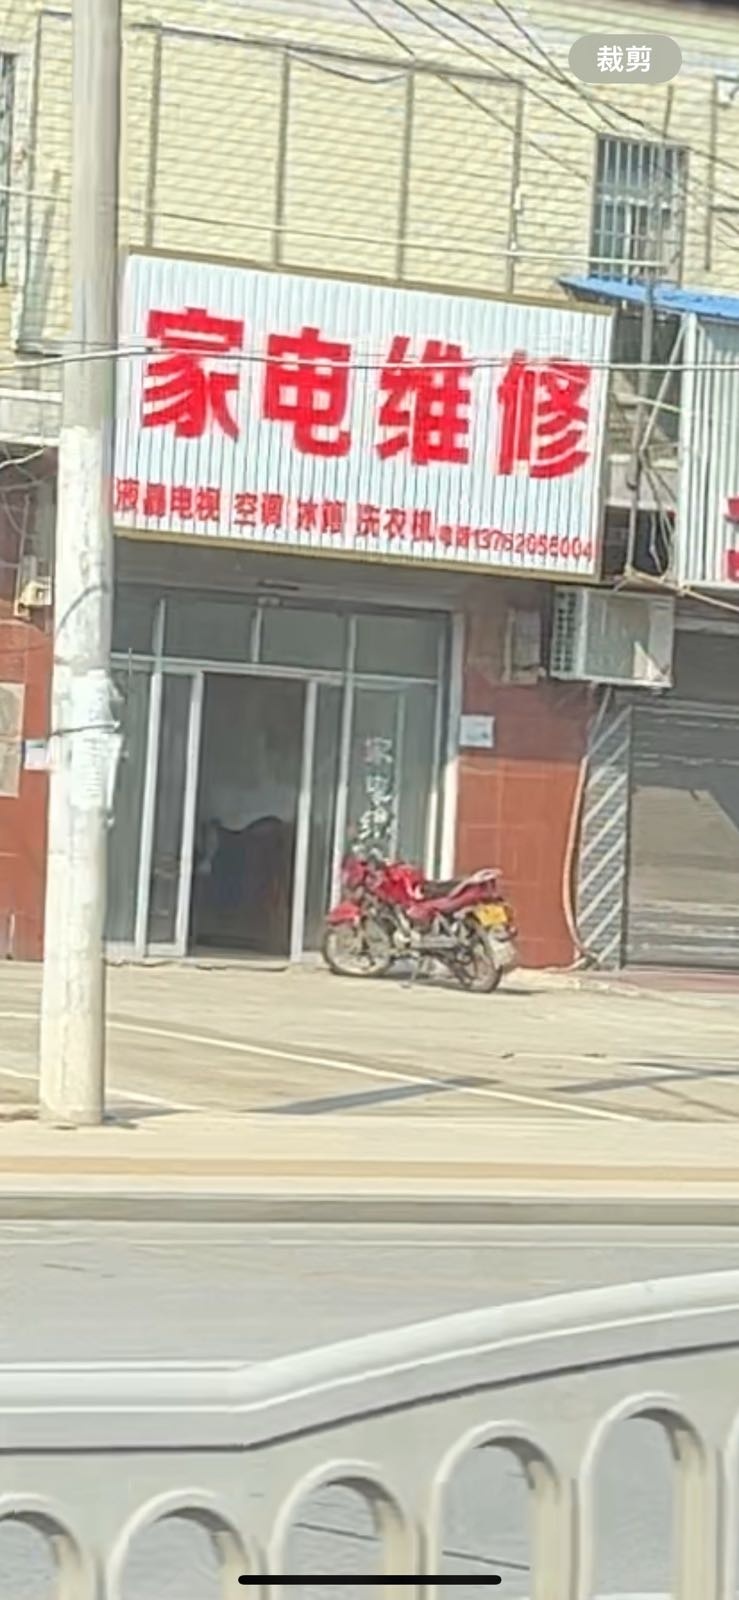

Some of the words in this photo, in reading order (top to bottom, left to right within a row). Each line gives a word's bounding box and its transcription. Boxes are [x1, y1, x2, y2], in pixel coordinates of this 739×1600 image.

[141, 307, 592, 479] 家电维修
[235, 493, 284, 528] 空调
[356, 504, 436, 542] 洗衣机
